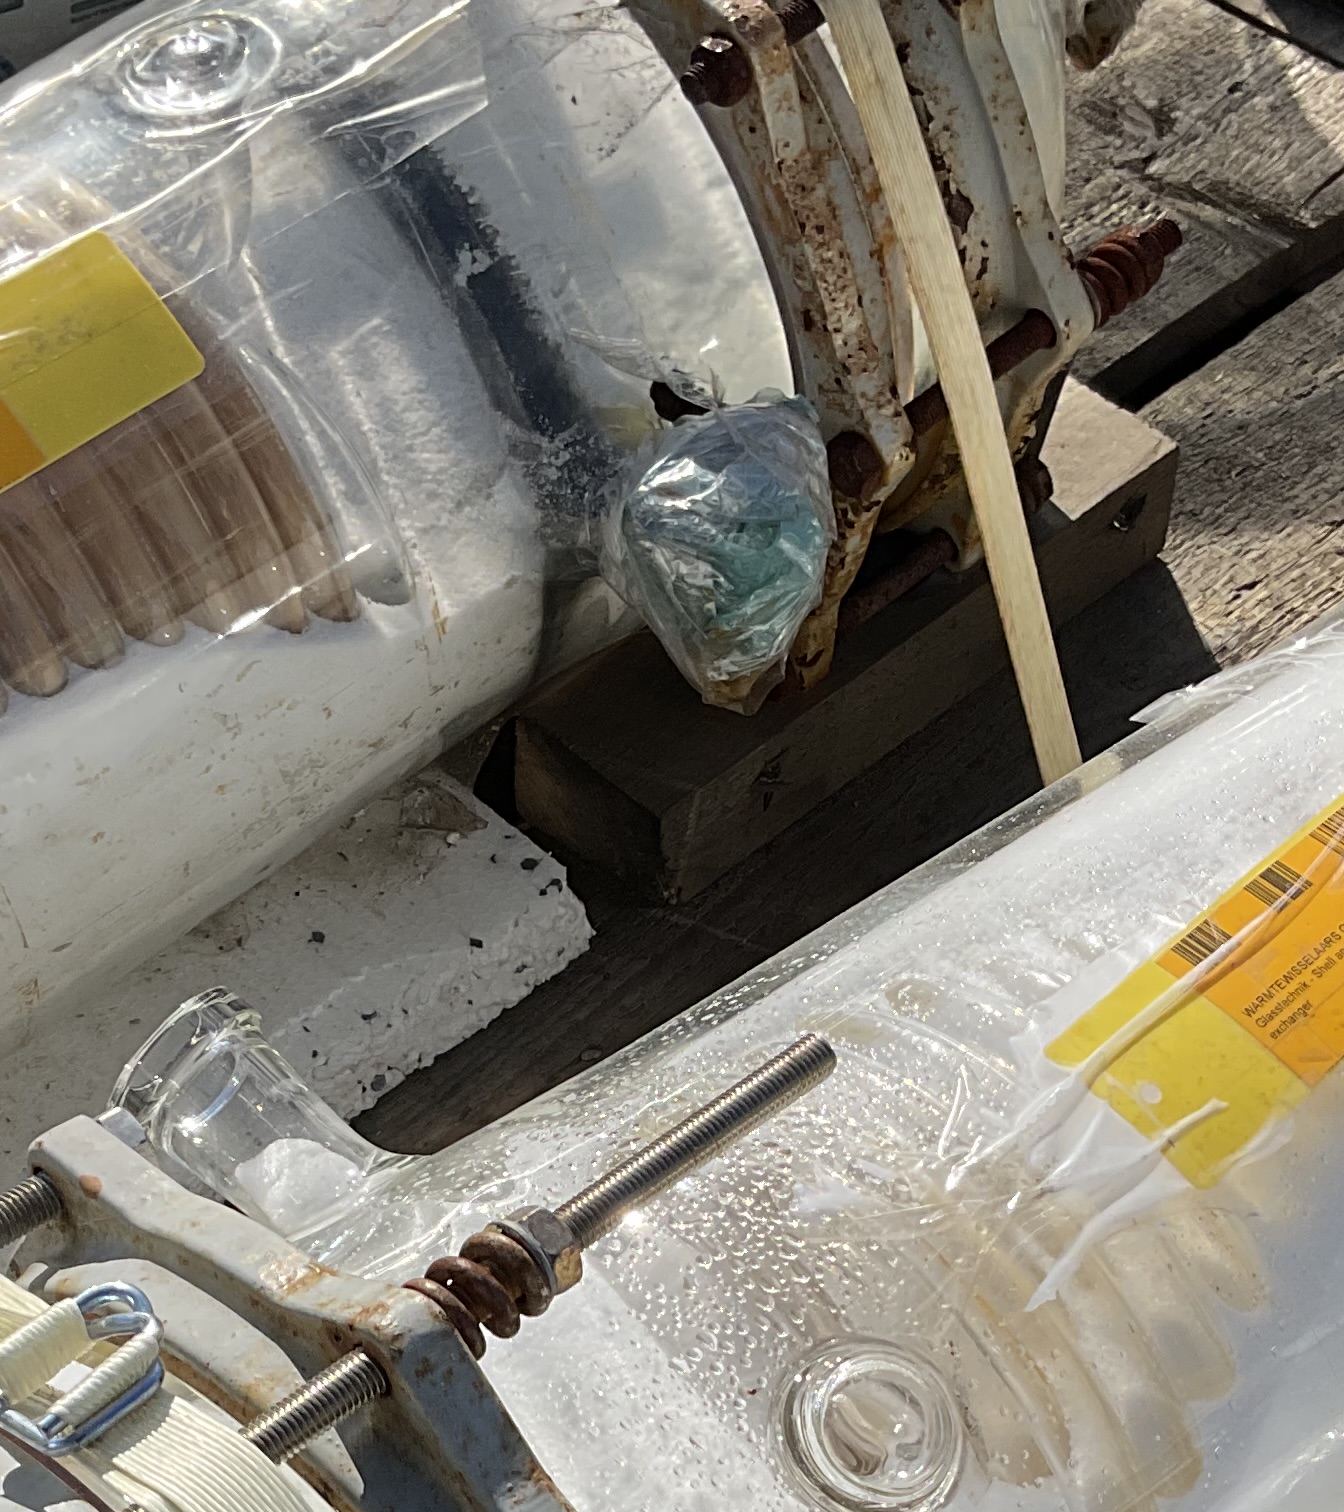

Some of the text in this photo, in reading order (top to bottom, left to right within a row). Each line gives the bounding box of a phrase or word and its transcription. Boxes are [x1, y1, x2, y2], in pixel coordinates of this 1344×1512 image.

[1242, 931, 1342, 1019] WARMTEWISSELAARS
[1255, 980, 1311, 1029] Glasstechnik
[1311, 955, 1338, 979] Shell
[1269, 1000, 1314, 1040] exchanger
